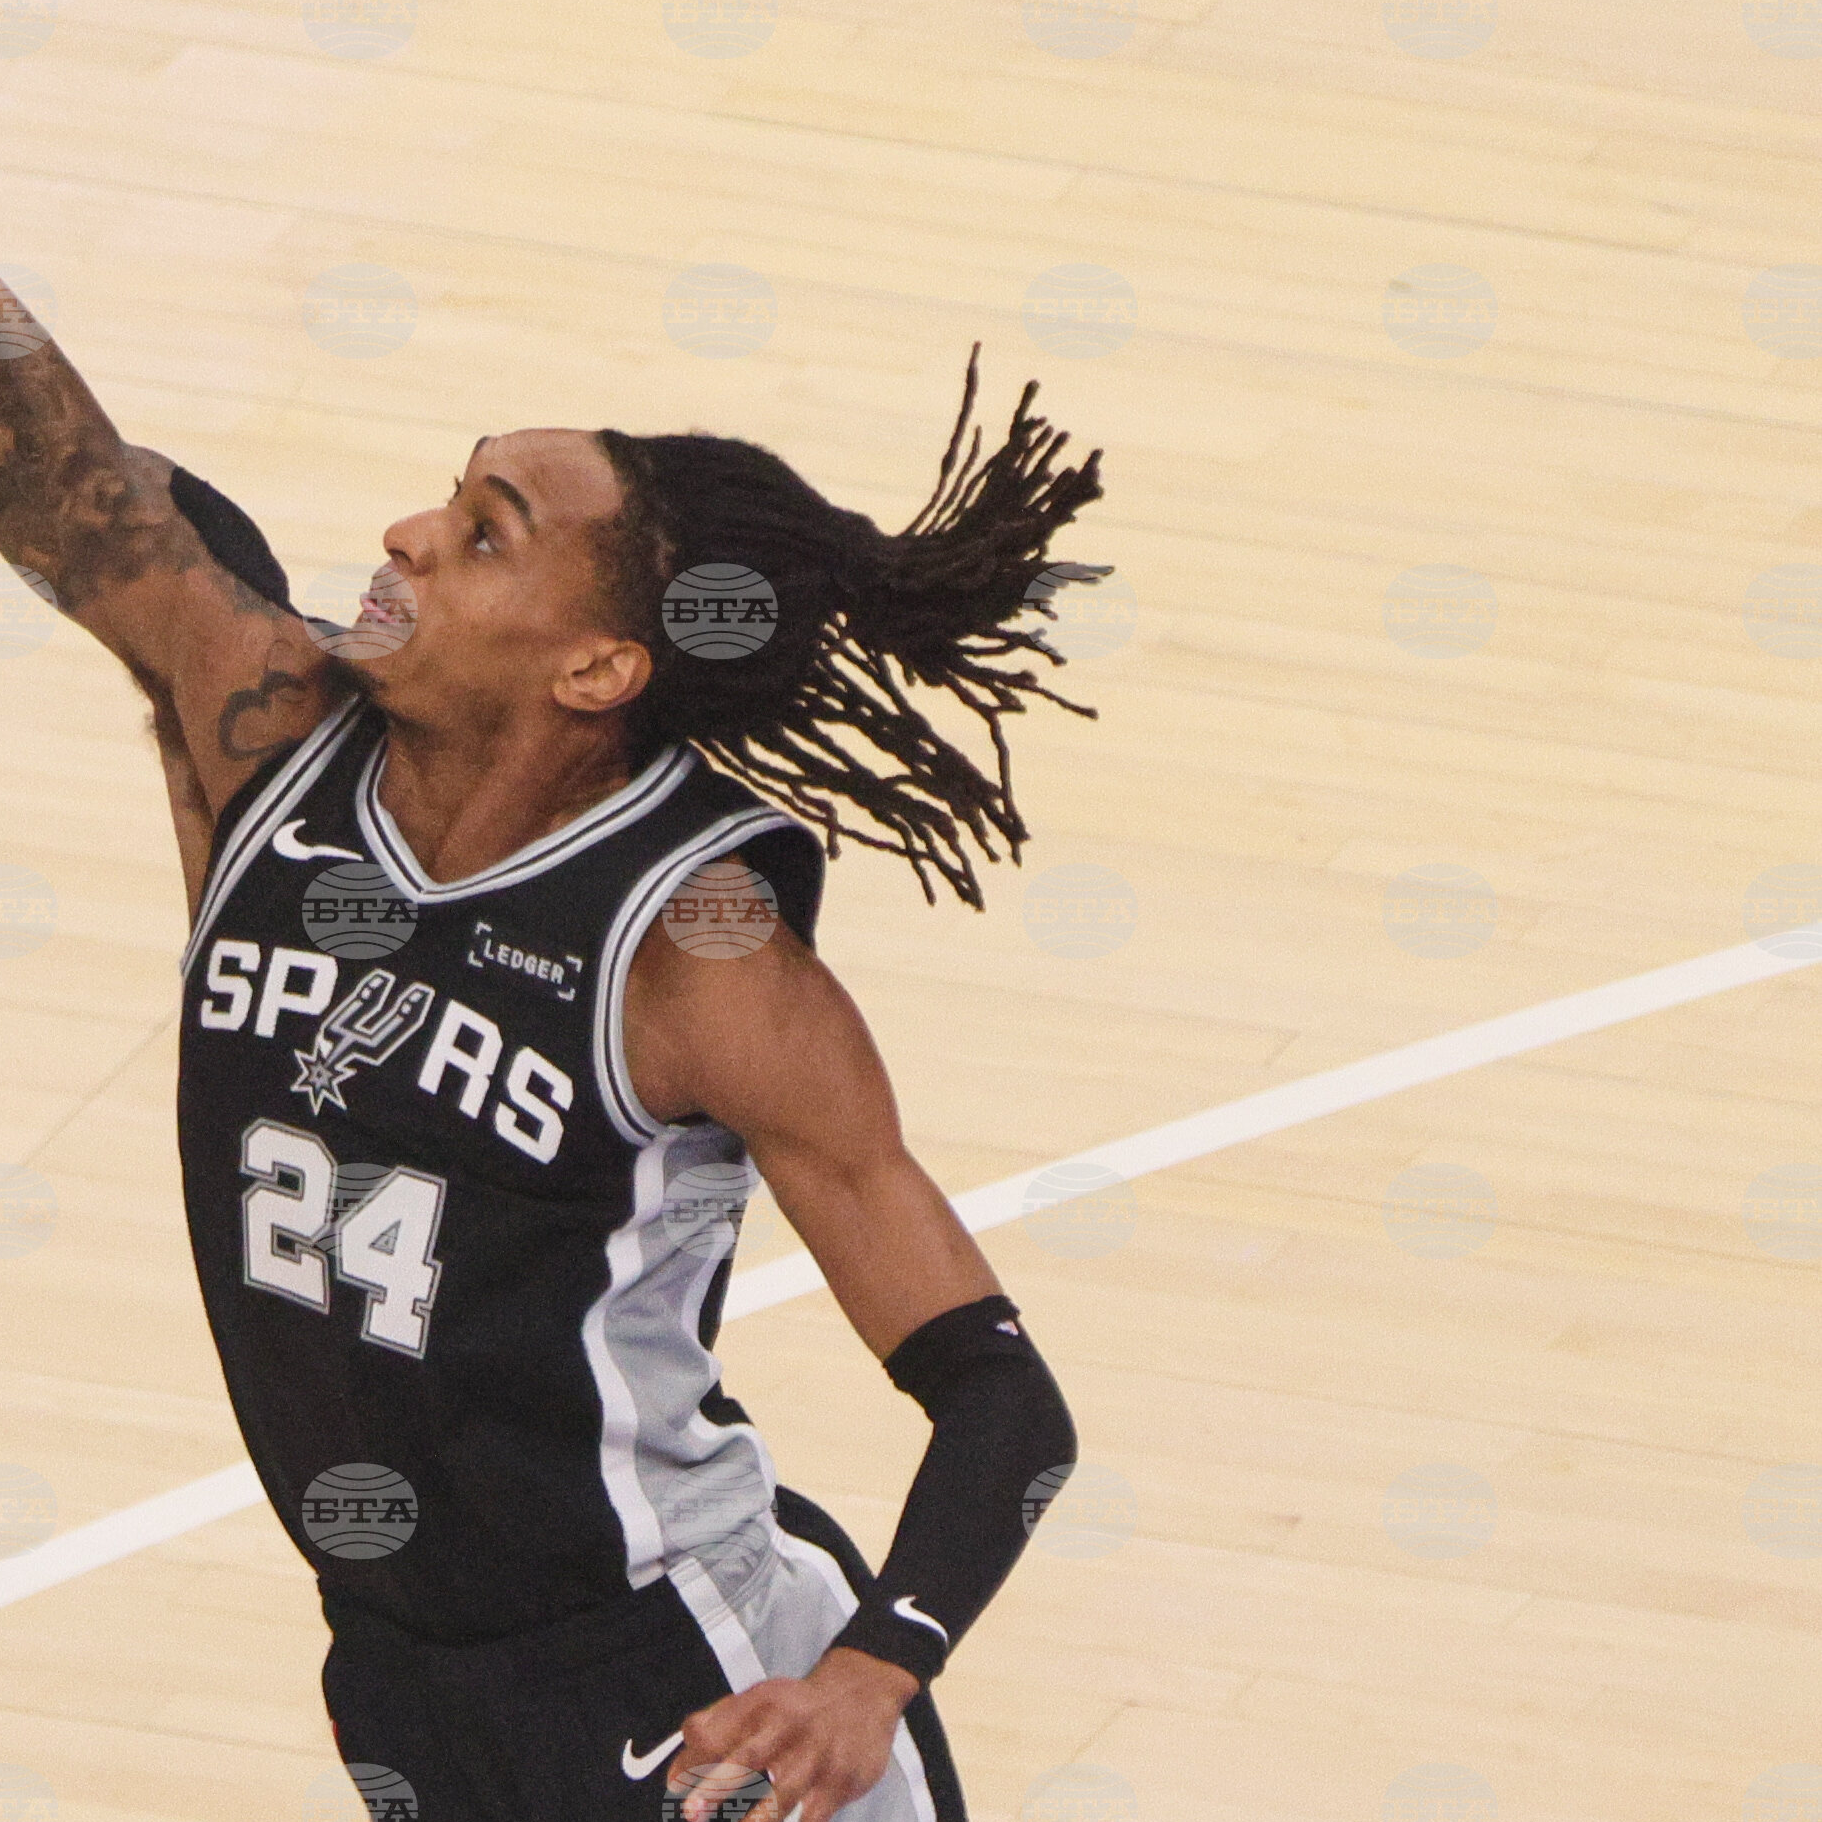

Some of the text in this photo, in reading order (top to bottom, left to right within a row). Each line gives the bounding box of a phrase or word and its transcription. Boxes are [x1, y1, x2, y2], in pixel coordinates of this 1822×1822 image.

[200, 938, 575, 1166] SPURS
[482, 938, 565, 986] LEDGER
[240, 1116, 448, 1360] 24
